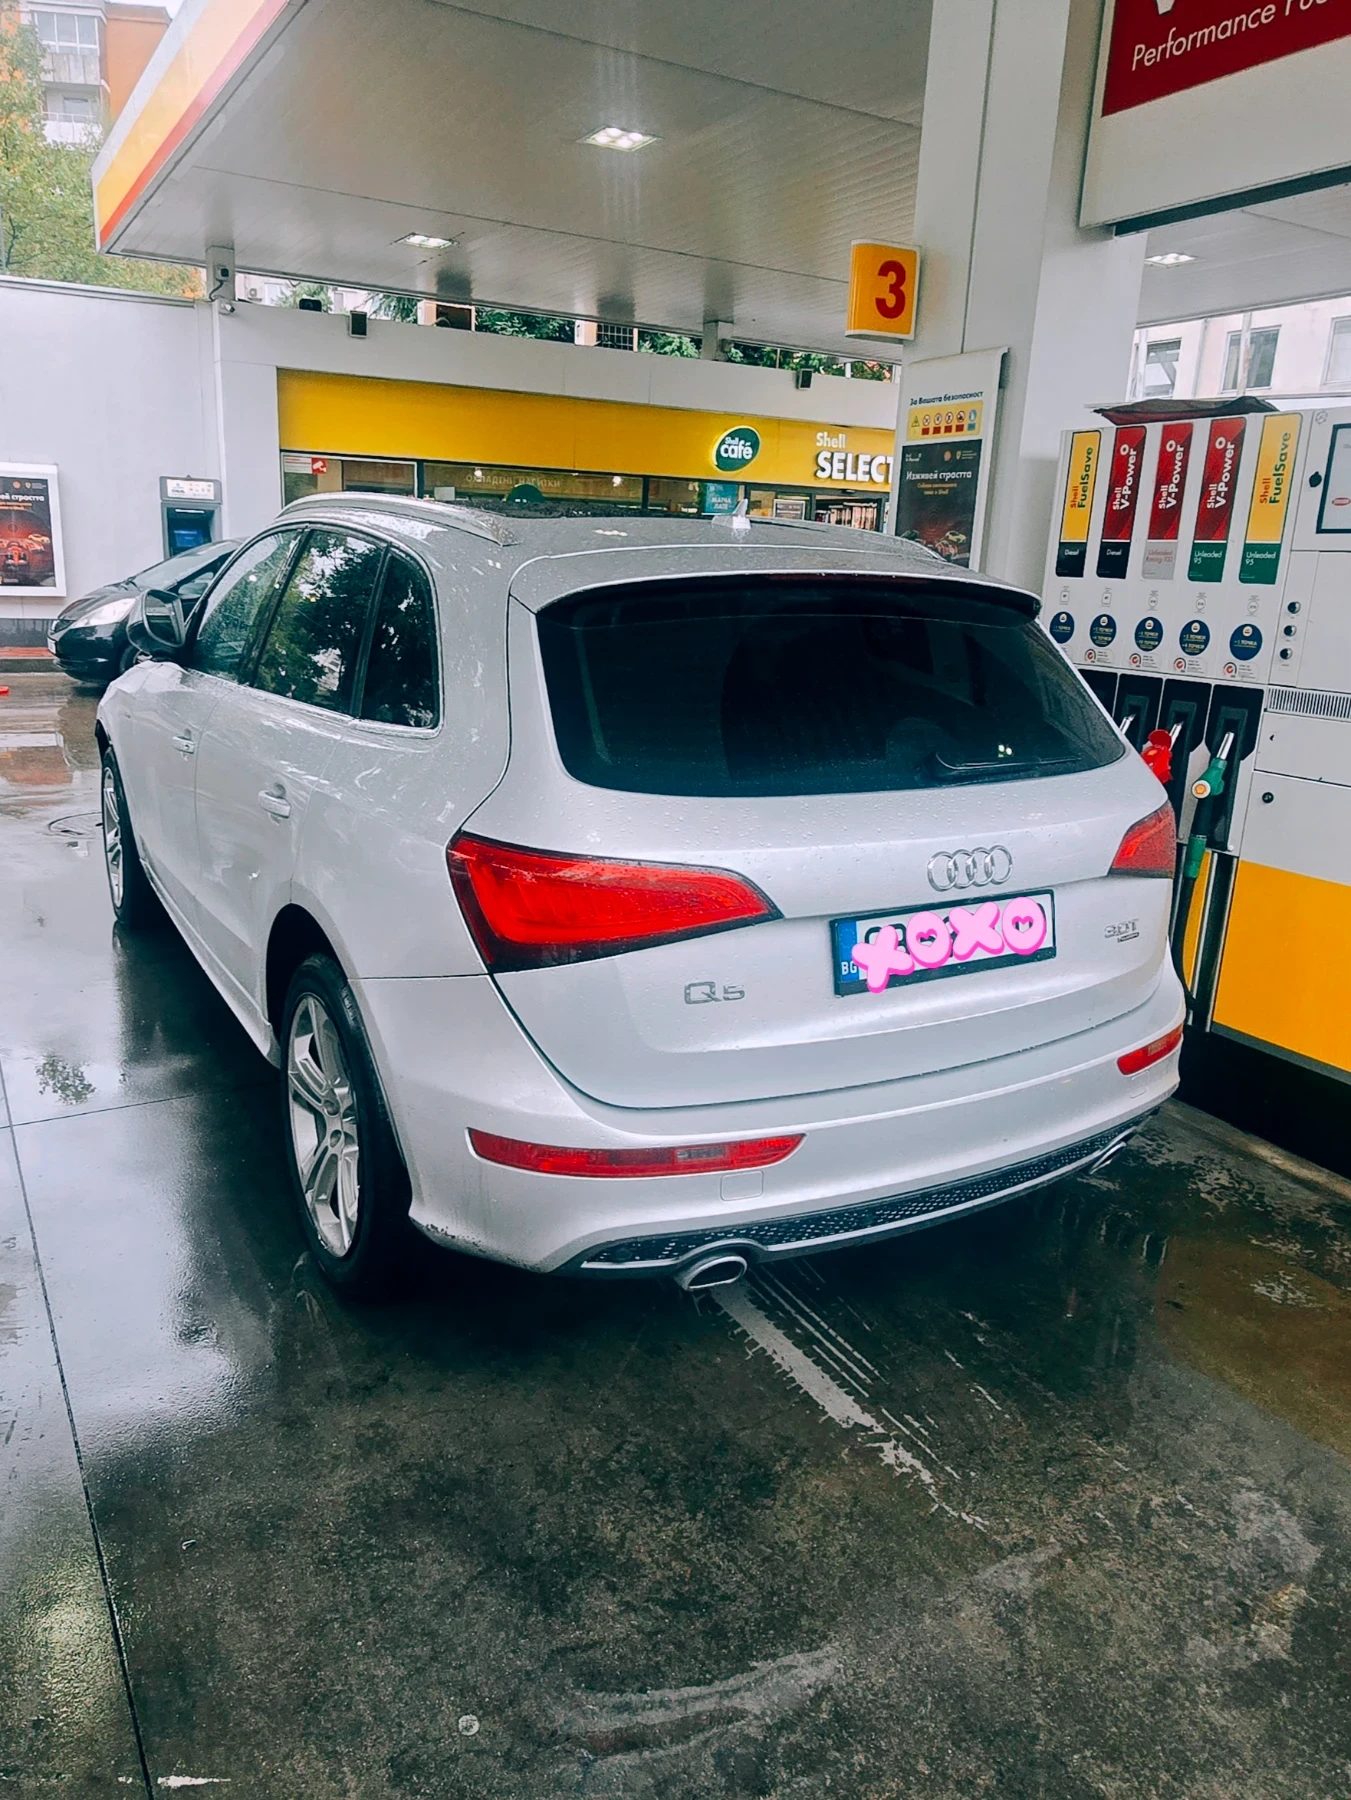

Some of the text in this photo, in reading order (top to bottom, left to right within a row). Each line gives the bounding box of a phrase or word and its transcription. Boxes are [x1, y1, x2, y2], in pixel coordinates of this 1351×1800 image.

[1131, 4, 1276, 71] Performance
[875, 260, 906, 319] 3
[720, 440, 753, 460] café
[725, 437, 740, 445] Shell
[816, 432, 846, 449] Shell
[939, 471, 972, 481] страстта
[1077, 447, 1094, 509] FuelSave
[1120, 448, 1138, 510] V-Power
[1166, 444, 1185, 509] V-Power
[1215, 441, 1235, 509] V-Power
[1269, 432, 1291, 504] FuelSave
[1070, 485, 1079, 509] Shell
[1112, 487, 1122, 510] Shell
[1158, 485, 1168, 509] Shell
[1207, 484, 1218, 509] Shell
[1260, 477, 1271, 504] Shell
[1194, 550, 1222, 558] Unleaded
[1245, 551, 1277, 559] Unleaded
[1245, 558, 1254, 566] 95
[841, 960, 858, 975] BG
[684, 981, 745, 1005] Q5
